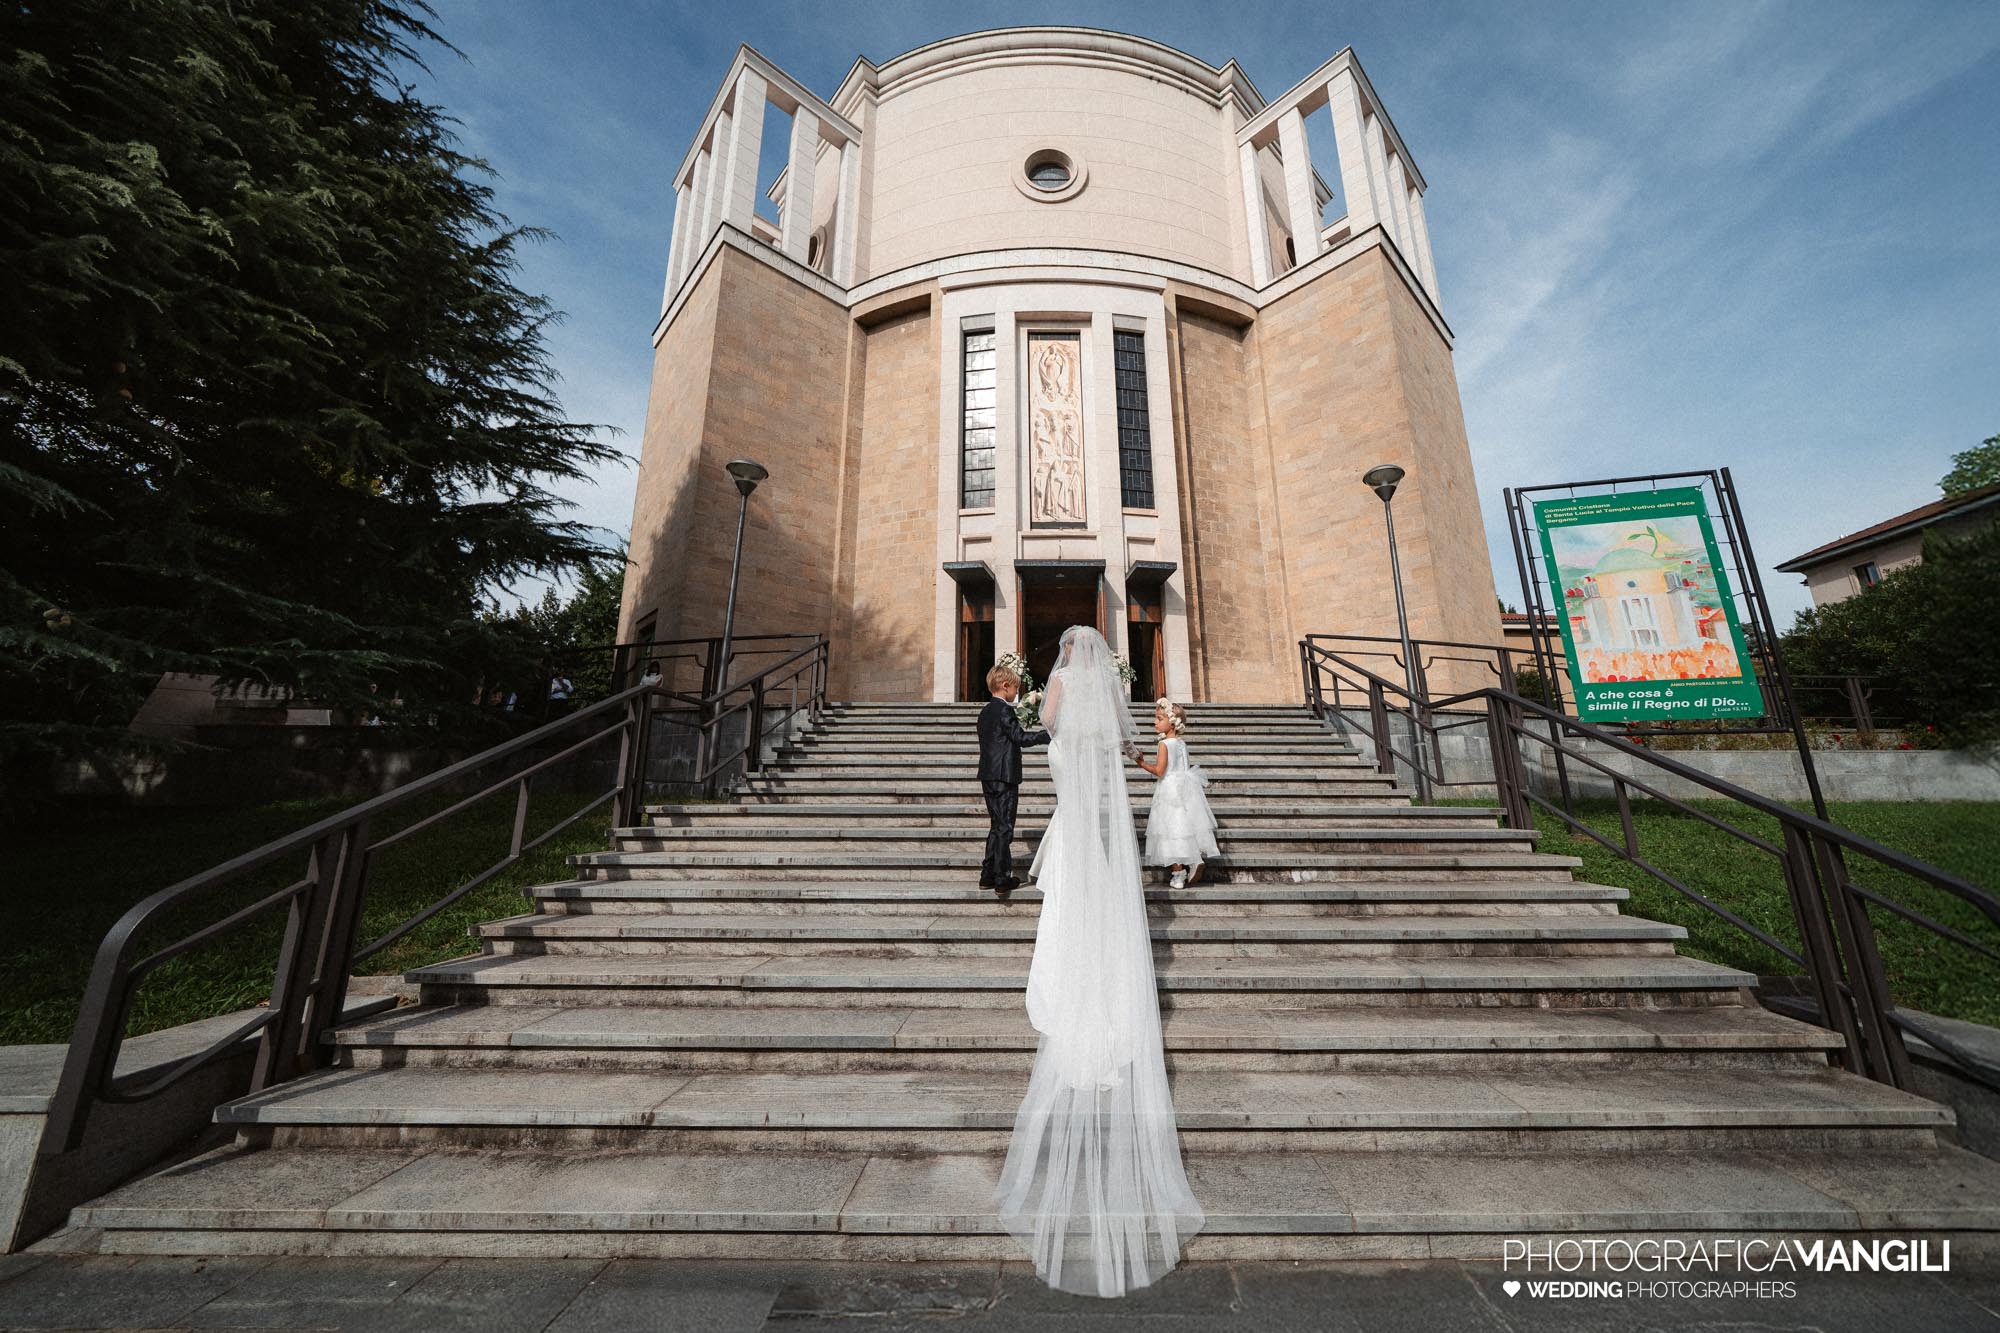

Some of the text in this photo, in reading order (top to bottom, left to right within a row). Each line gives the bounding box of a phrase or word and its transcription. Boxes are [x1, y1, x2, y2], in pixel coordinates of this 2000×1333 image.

[1585, 688, 1673, 700] A che cosa è
[1588, 697, 1749, 711] simile il Regno di Dio...
